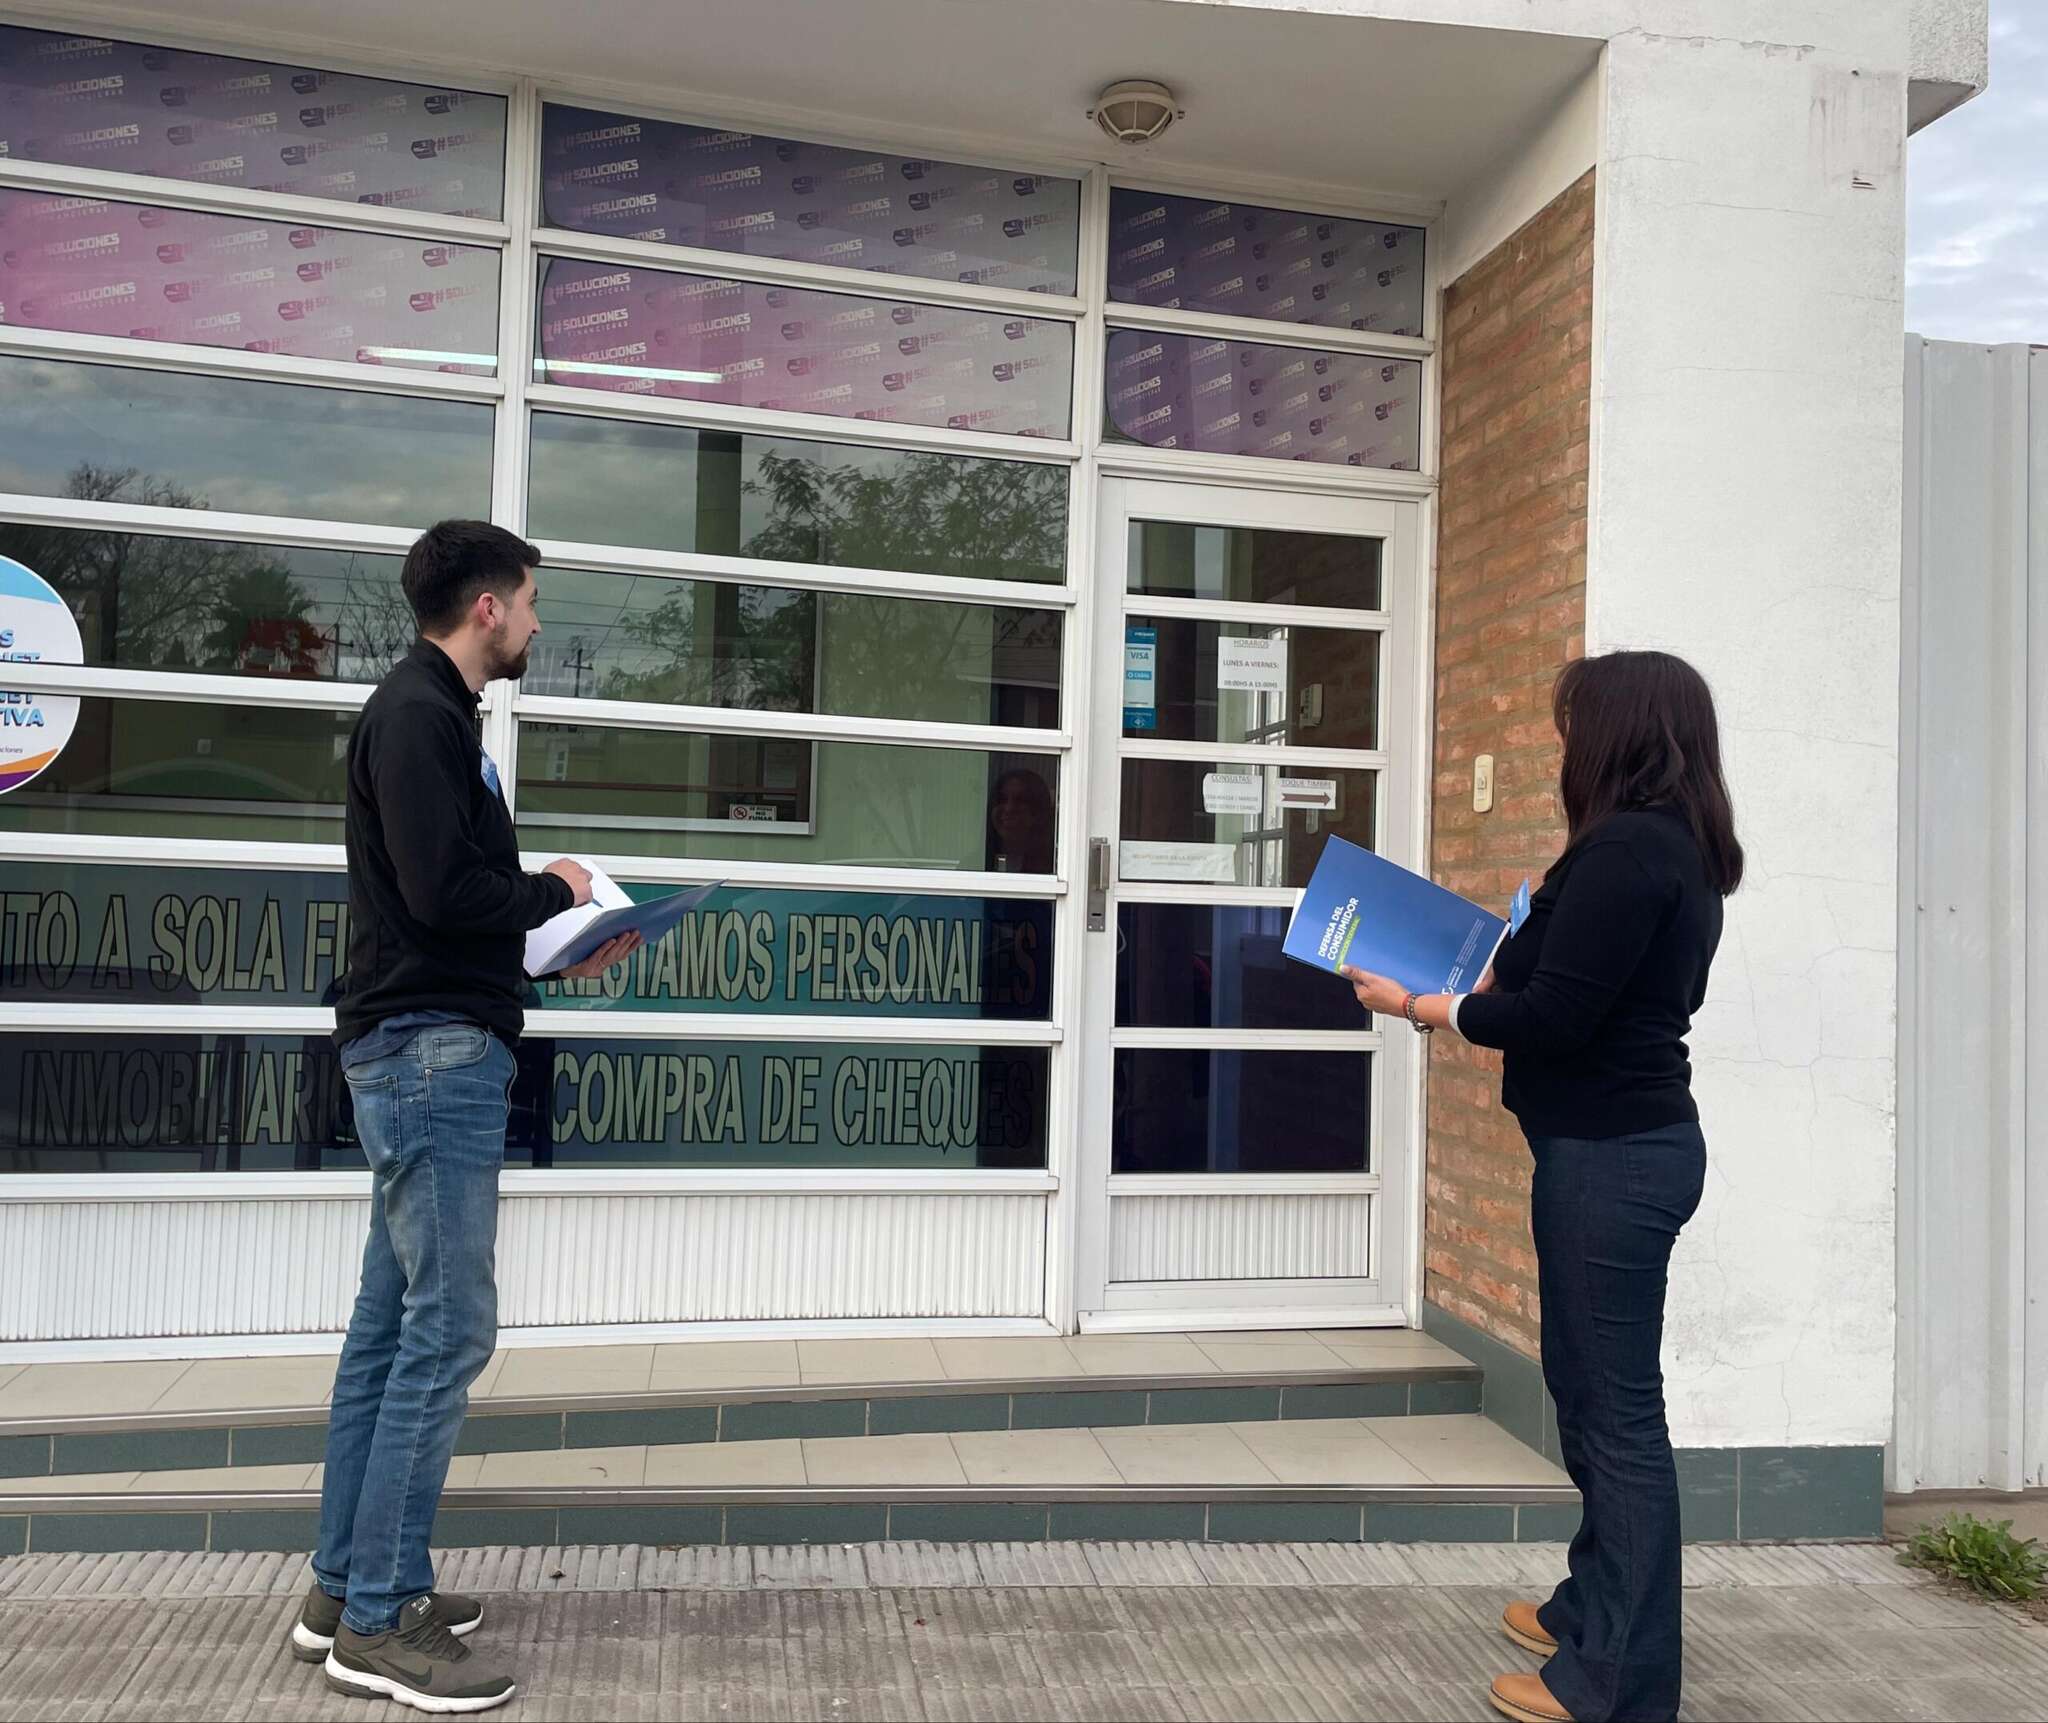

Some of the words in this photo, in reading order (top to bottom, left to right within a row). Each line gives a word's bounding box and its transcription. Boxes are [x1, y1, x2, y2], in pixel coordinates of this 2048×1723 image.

[90, 894, 133, 989] A
[148, 889, 288, 992] SOLA
[1318, 922, 1337, 957] DEFENSA
[1331, 905, 1344, 922] DEL
[1327, 897, 1359, 960] CONSUMIDOR
[551, 1050, 747, 1146] COMPRA
[759, 1056, 822, 1145] DE
